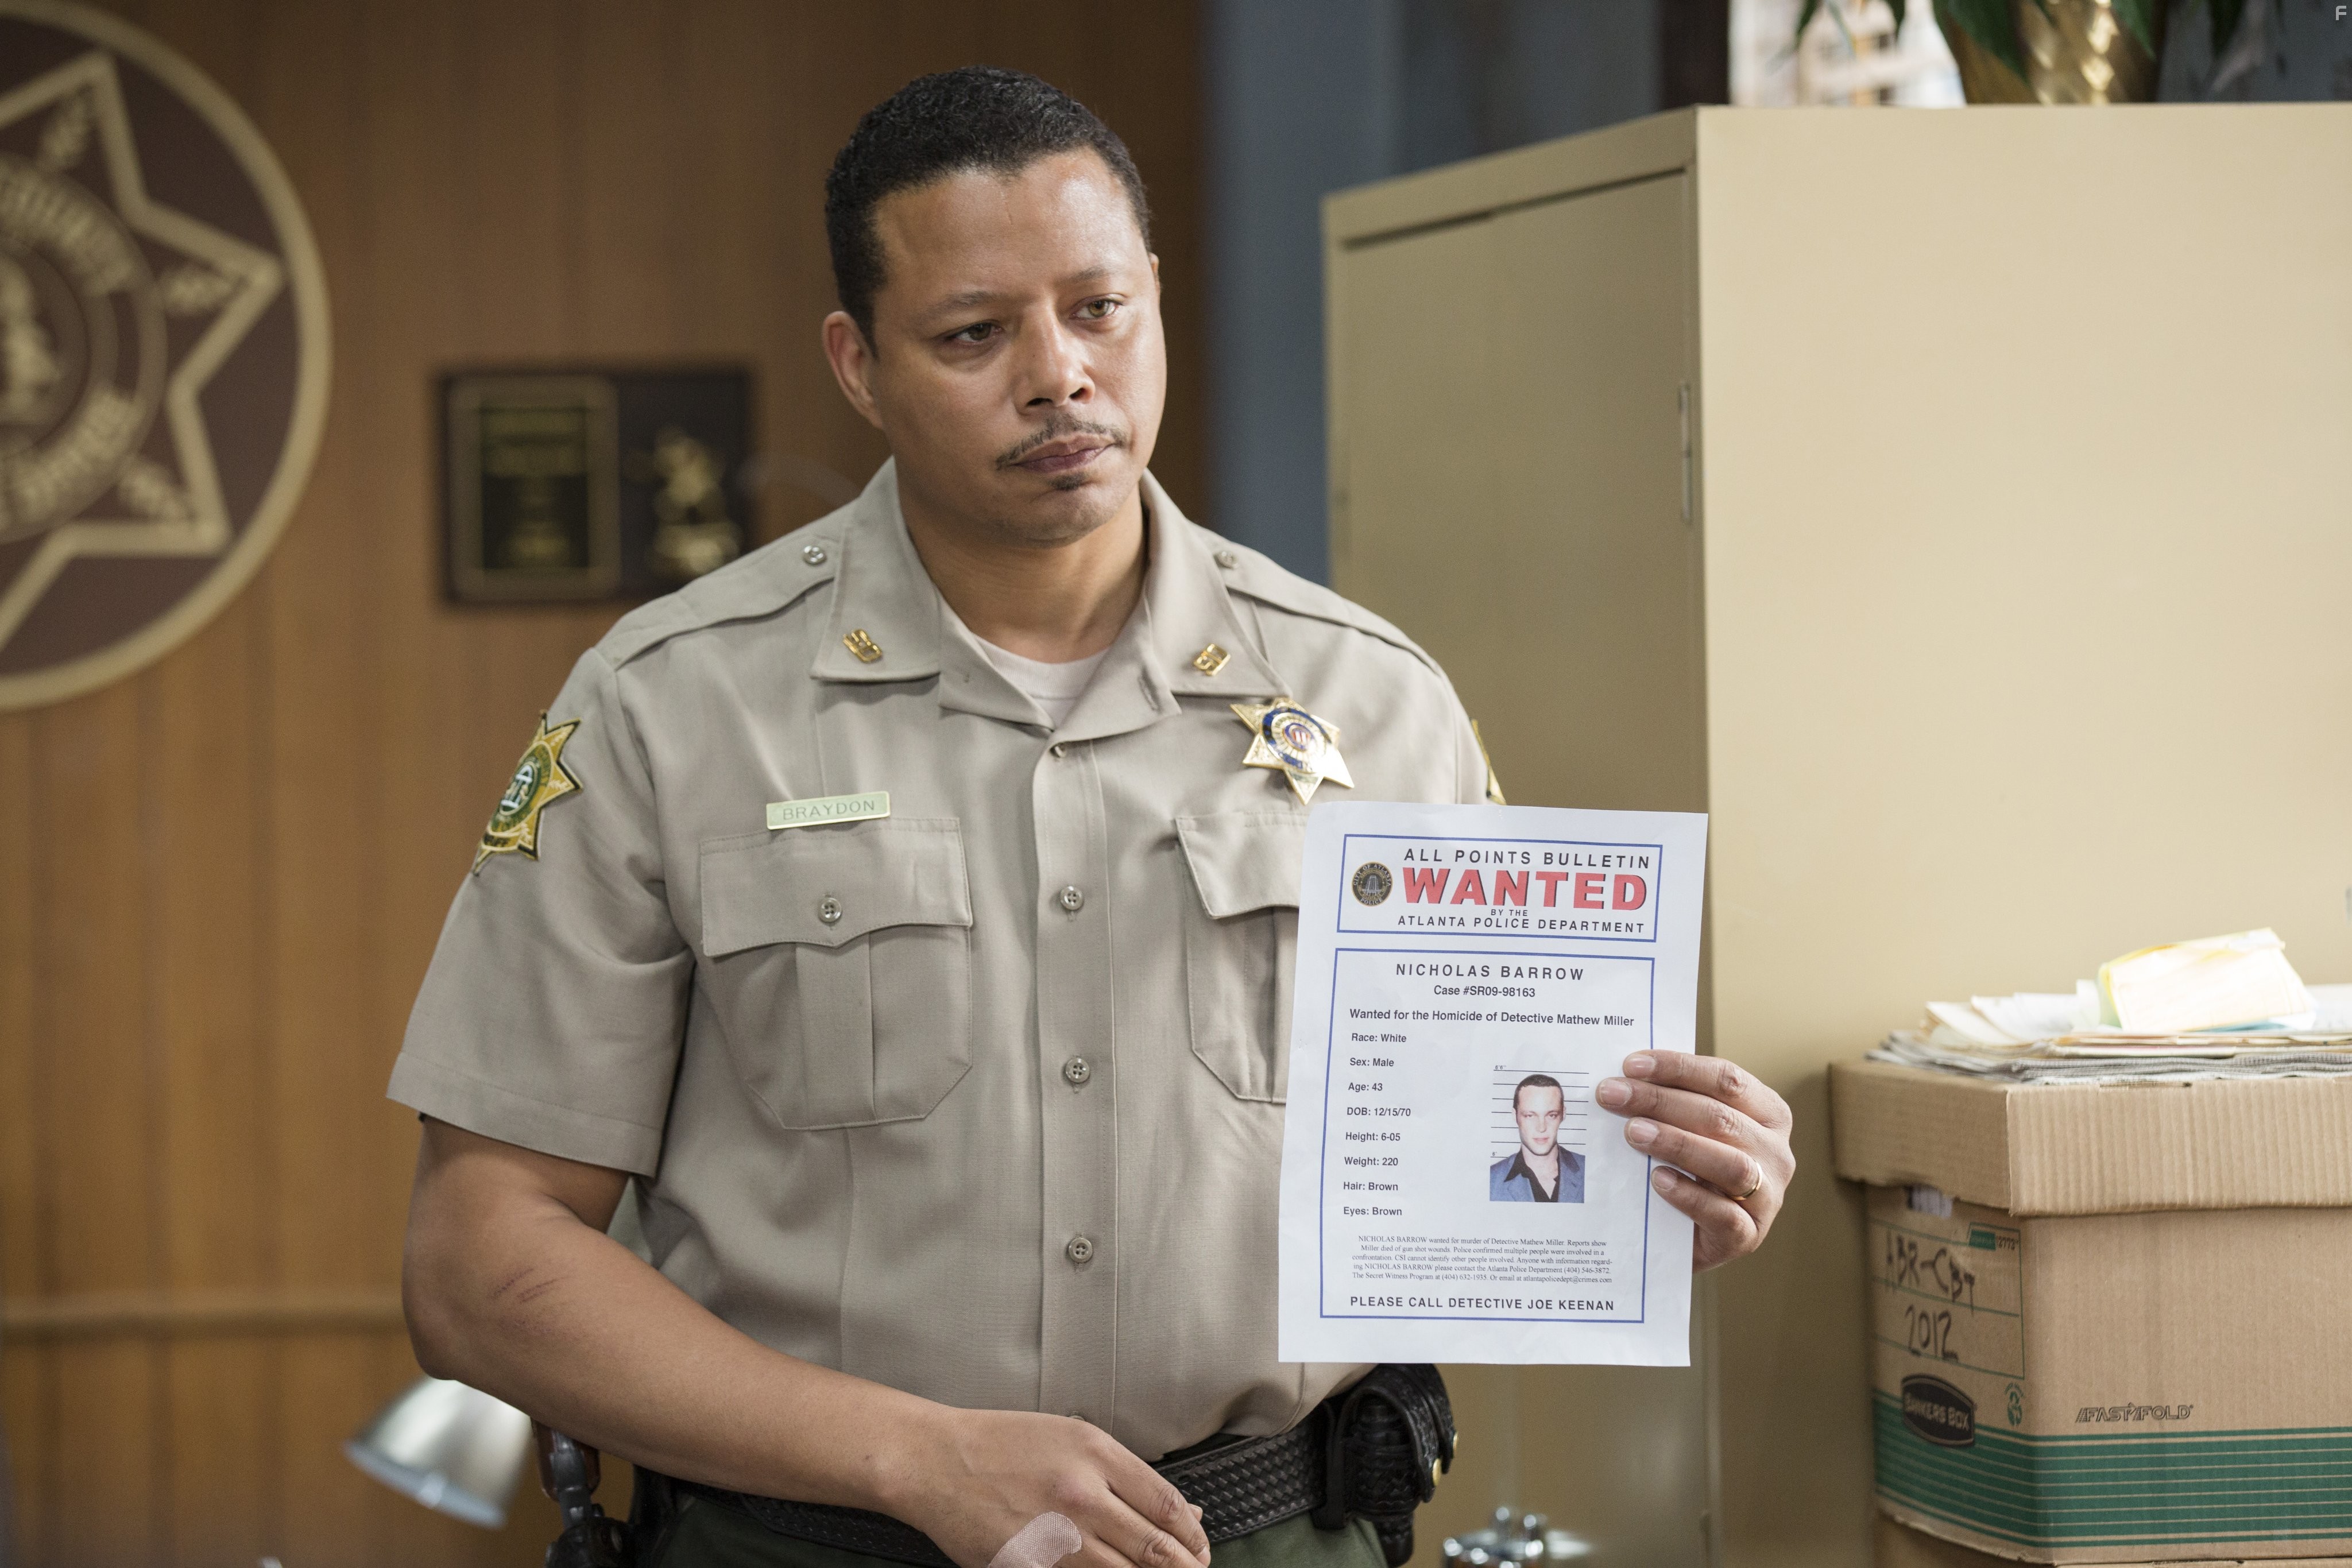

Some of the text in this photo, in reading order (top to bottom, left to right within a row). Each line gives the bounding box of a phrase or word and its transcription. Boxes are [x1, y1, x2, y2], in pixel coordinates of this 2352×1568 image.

[783, 800, 875, 820] BRAYDON
[1403, 847, 1649, 869] ALL POINTS BULLETIN
[1353, 870, 1362, 886] CITY
[1373, 863, 1392, 886] ATLANTA
[1402, 866, 1647, 911] WANTED
[1360, 897, 1383, 905] POLICE
[1397, 915, 1644, 933] ATLANTA POLICE DEPARTMENT
[1395, 963, 1584, 981] NICHOLAS BARROW
[1433, 984, 1535, 997] Case #SR09-98163
[1349, 1008, 1635, 1026] Wanted for the Homicide of Detective Mathew Miller
[1351, 1032, 1407, 1043] Race: White
[1349, 1056, 1394, 1067] Sex: Male
[1348, 1082, 1383, 1093] Age: 43
[1347, 1106, 1411, 1117] DOB: 12/15/70
[1345, 1131, 1401, 1143] Height: 6-05
[1344, 1156, 1399, 1167] Weight: 220
[1343, 1181, 1398, 1191] Hair: Brown
[1343, 1206, 1402, 1217] Eyes: Brown
[1566, 1239, 1590, 1248] Reports
[1503, 1246, 1529, 1255] multiple
[1528, 1248, 1550, 1256] people
[1565, 1248, 1593, 1256] involved
[1427, 1255, 1450, 1263] identify
[1467, 1255, 1488, 1264] people
[1516, 1256, 1540, 1265] Anyone
[1434, 1264, 1453, 1272] please
[1527, 1265, 1563, 1274] Department
[1409, 1272, 1434, 1281] Program
[1350, 1296, 1614, 1310] PLEASE CALL DETECTIVE JOE KEENAN
[1905, 1304, 1959, 1364] 2012
[1947, 1407, 1970, 1431] BOX
